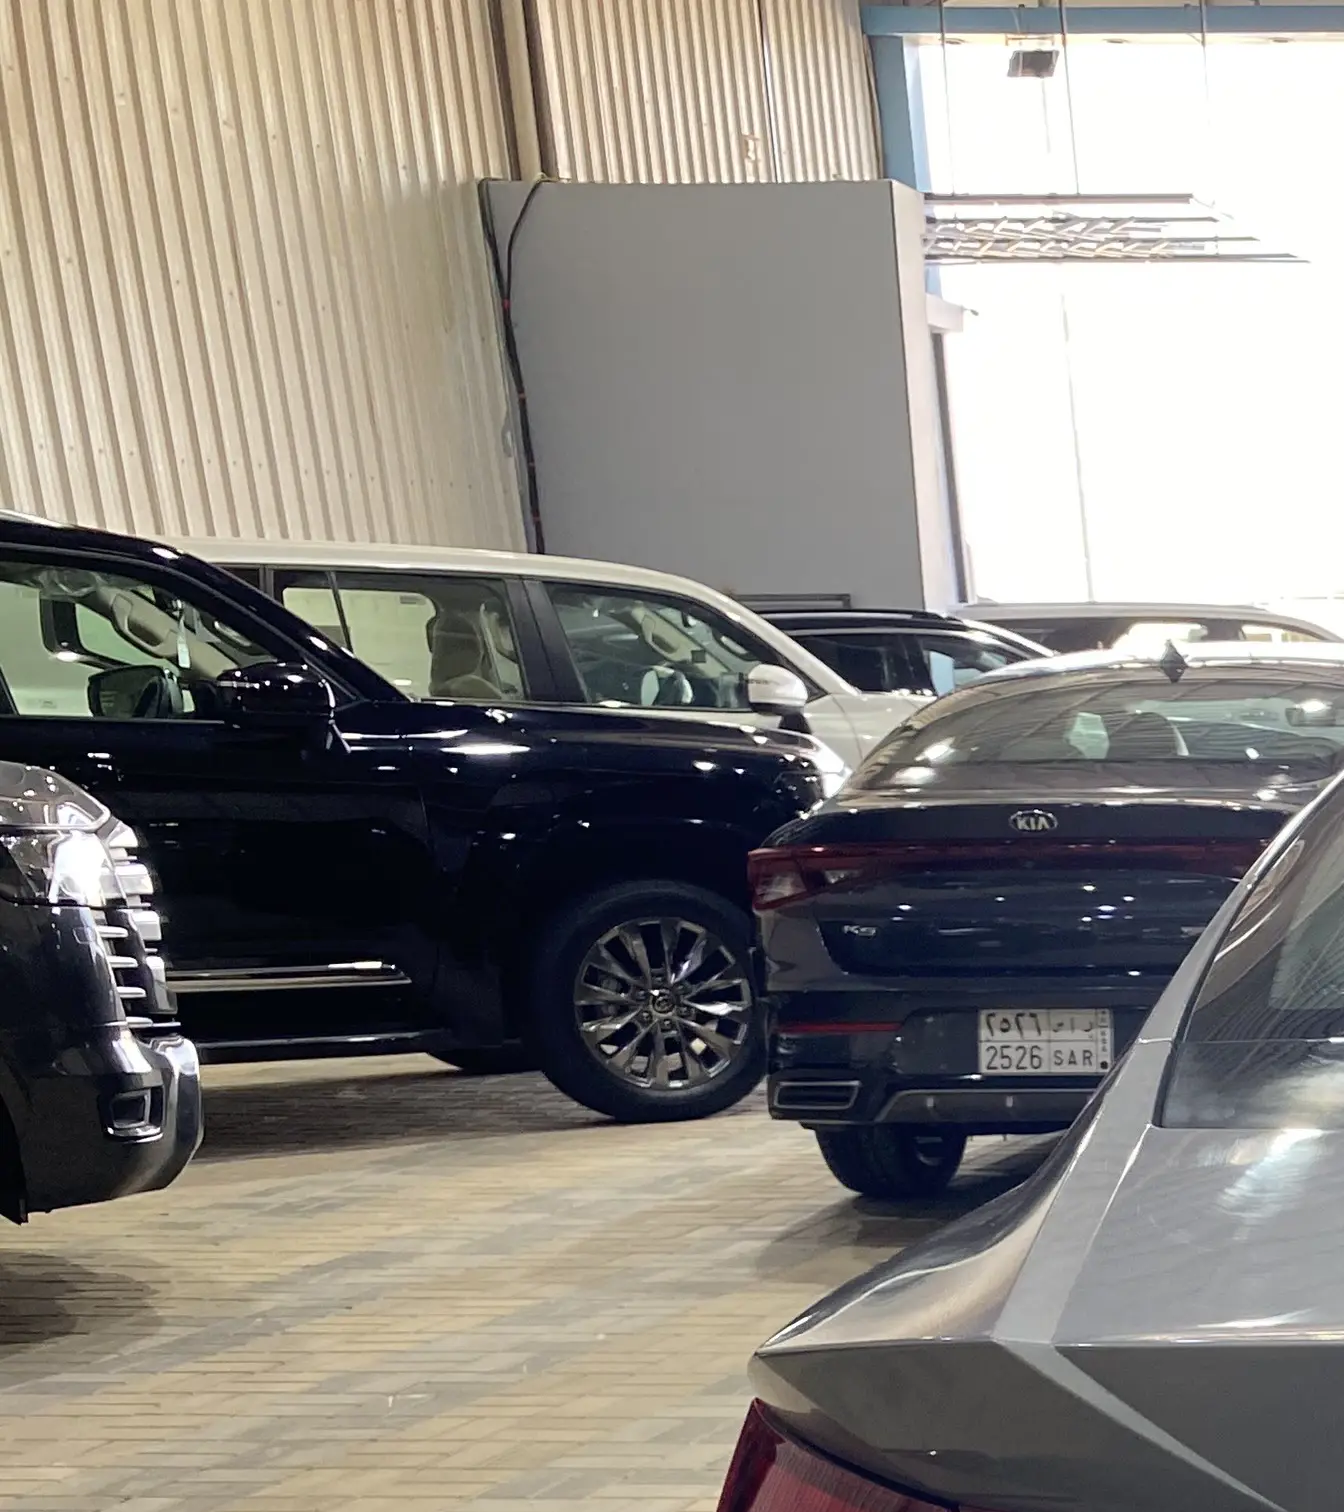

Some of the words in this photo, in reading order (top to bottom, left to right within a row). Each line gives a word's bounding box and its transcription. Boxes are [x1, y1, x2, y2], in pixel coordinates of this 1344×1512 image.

[1016, 815, 1050, 832] KIA
[985, 1044, 1042, 1071] 2526
[1053, 1049, 1094, 1067] SAR
